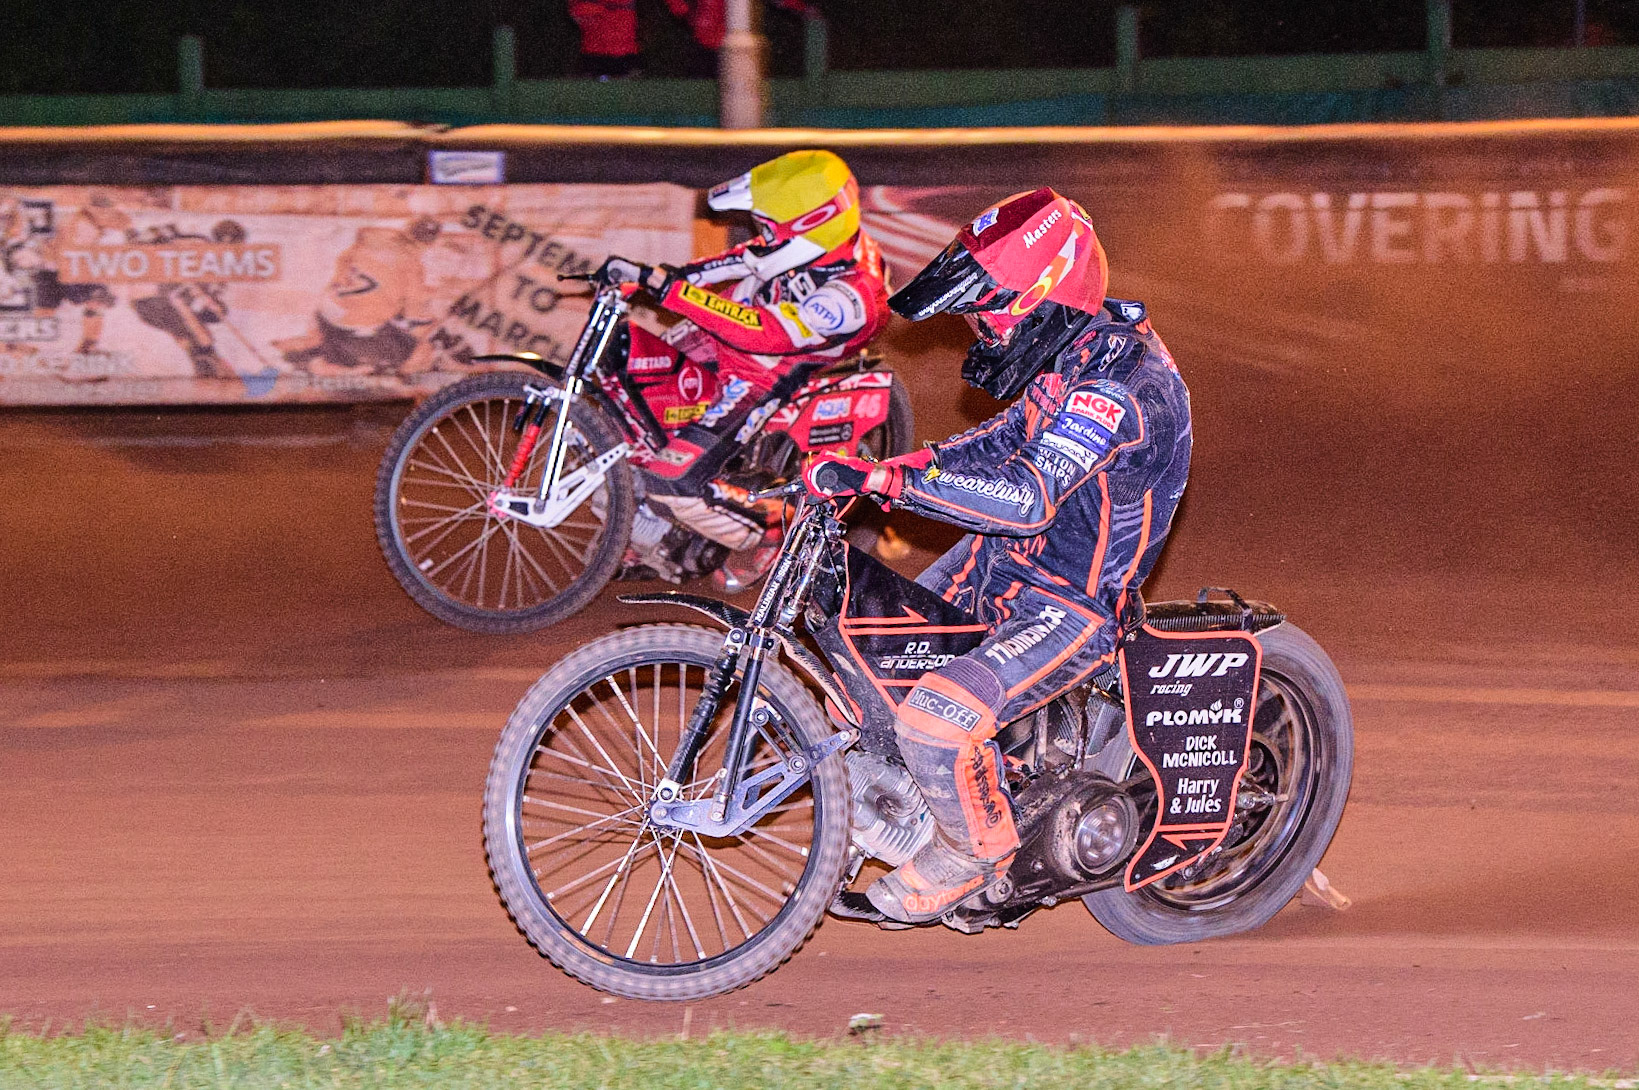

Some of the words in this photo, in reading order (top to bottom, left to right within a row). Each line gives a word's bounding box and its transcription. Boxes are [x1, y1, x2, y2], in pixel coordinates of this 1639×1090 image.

[462, 204, 592, 274] SEPTEM
[1023, 209, 1063, 249] Masters
[64, 250, 149, 278] TWO
[161, 250, 276, 278] TEAMS
[513, 274, 558, 313] TO
[1071, 408, 1095, 418] SPARK
[1096, 414, 1114, 430] PLUGS
[1072, 393, 1123, 422] NGK
[1035, 456, 1071, 487] SKIPS
[939, 472, 1035, 515] wearelusty
[905, 641, 931, 655] R.D.
[1148, 653, 1249, 678] JWP
[1150, 681, 1193, 697] racing
[911, 689, 980, 727] Muc-Off
[1186, 735, 1217, 751] DICK
[1163, 750, 1237, 768] MCNICOLL
[1177, 777, 1219, 797] Harry
[1170, 797, 1182, 814] &
[1184, 796, 1222, 814] Jules
